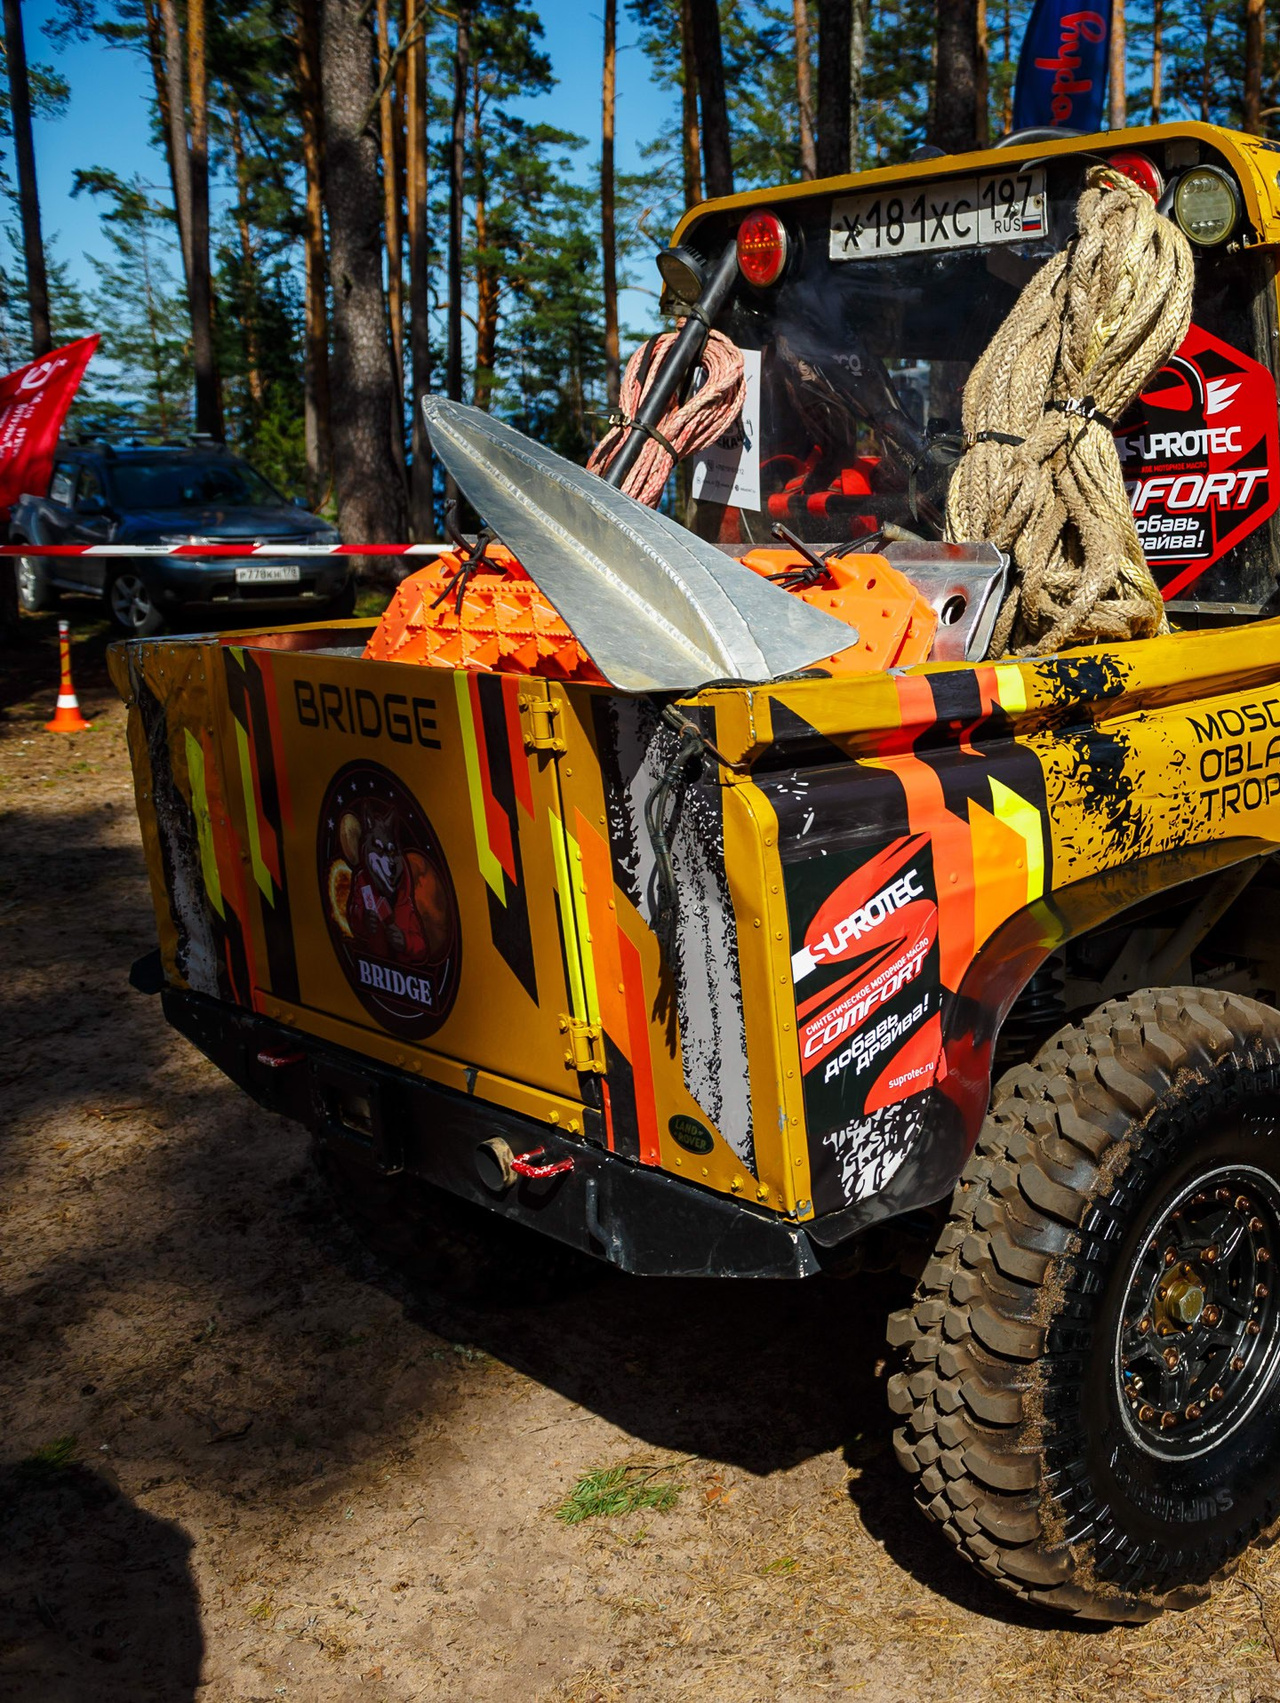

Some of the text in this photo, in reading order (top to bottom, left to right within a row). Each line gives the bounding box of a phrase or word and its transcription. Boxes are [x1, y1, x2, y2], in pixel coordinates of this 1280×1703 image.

[1051, 10, 1107, 126] ophy
[982, 175, 1032, 222] 197
[994, 217, 1021, 234] RUS
[1118, 426, 1243, 461] SUPROTEC
[1135, 514, 1199, 533] обавь
[294, 679, 442, 750] BRIDGE
[806, 869, 924, 957] SUPROTEC
[358, 959, 433, 1006] BRIDGE
[804, 948, 928, 1059] COMFORT
[805, 936, 929, 1036] СИНТЕТИЧЕСКОЕ МОТОРНОЕ МАСЛО
[888, 1060, 935, 1089] suprotec.ru
[675, 1117, 698, 1136] LAND
[677, 1133, 707, 1150] ROVER
